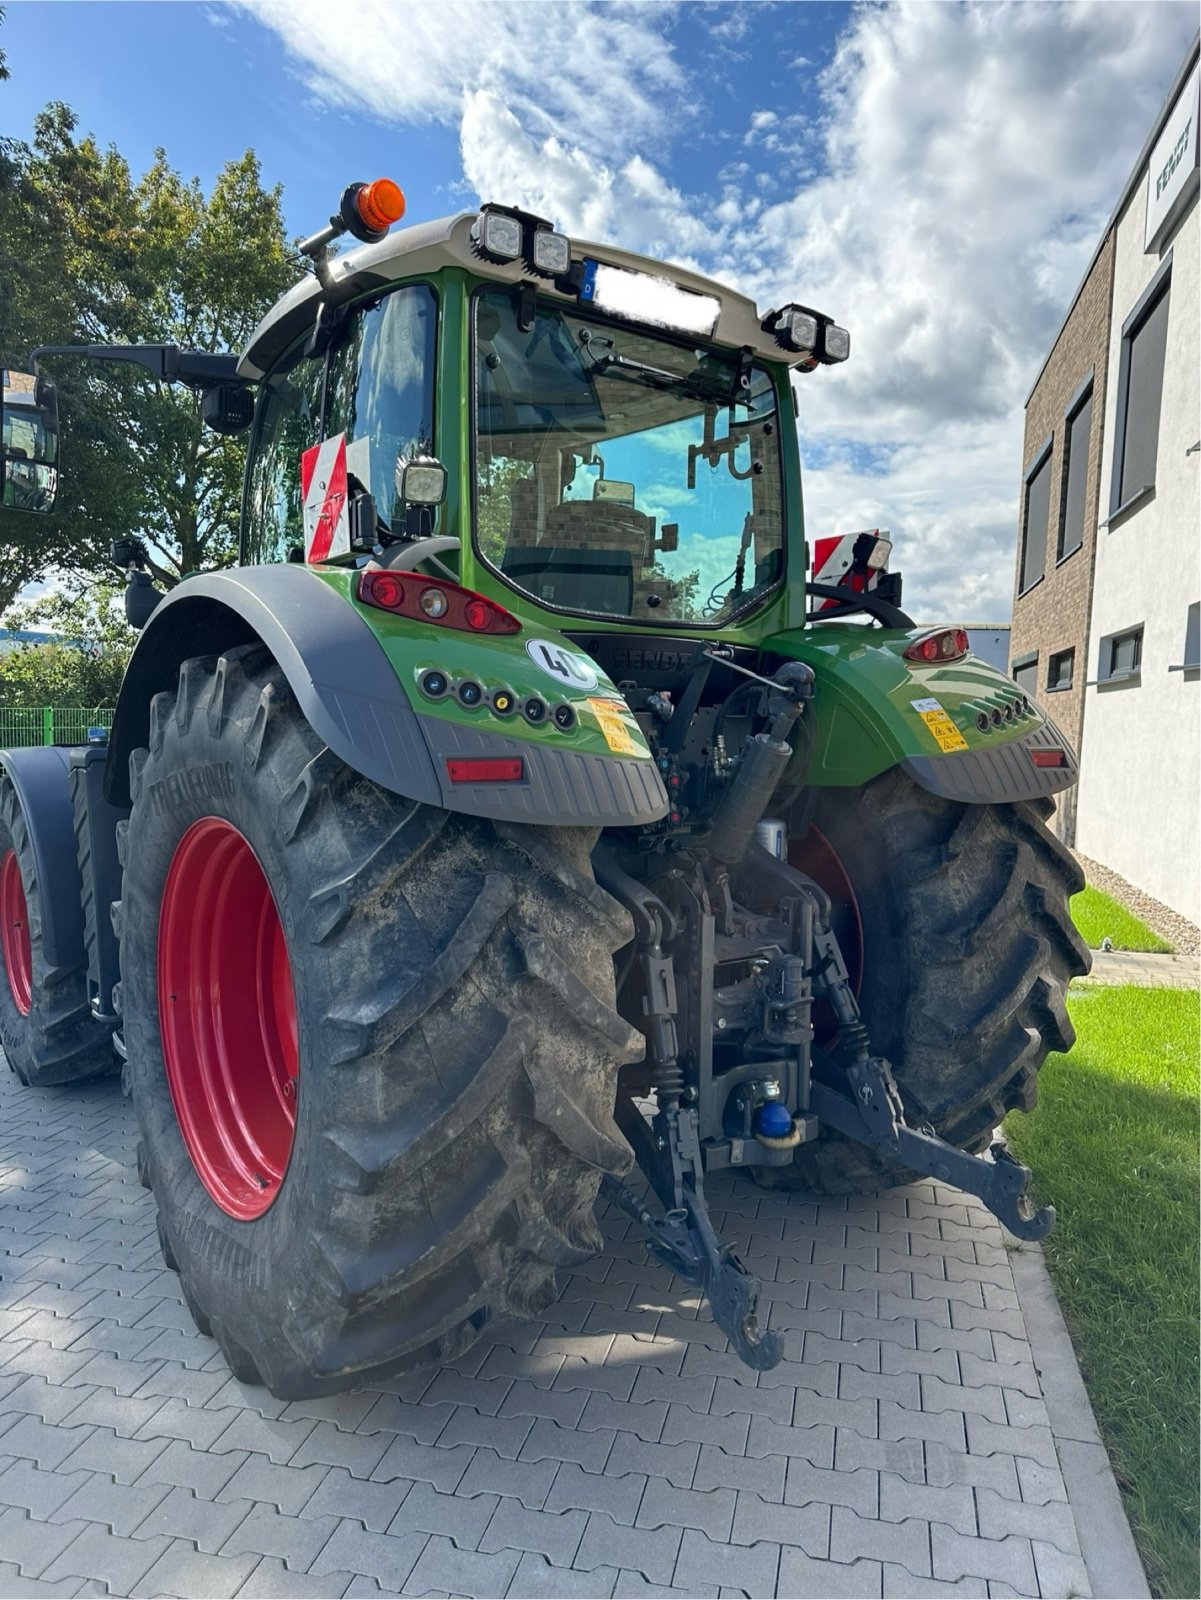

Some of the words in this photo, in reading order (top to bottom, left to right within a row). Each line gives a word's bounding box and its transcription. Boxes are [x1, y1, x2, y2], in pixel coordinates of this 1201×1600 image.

[1156, 116, 1193, 201] FENDT
[584, 283, 591, 294] D
[538, 644, 588, 683] 40
[613, 648, 694, 673] FENDT
